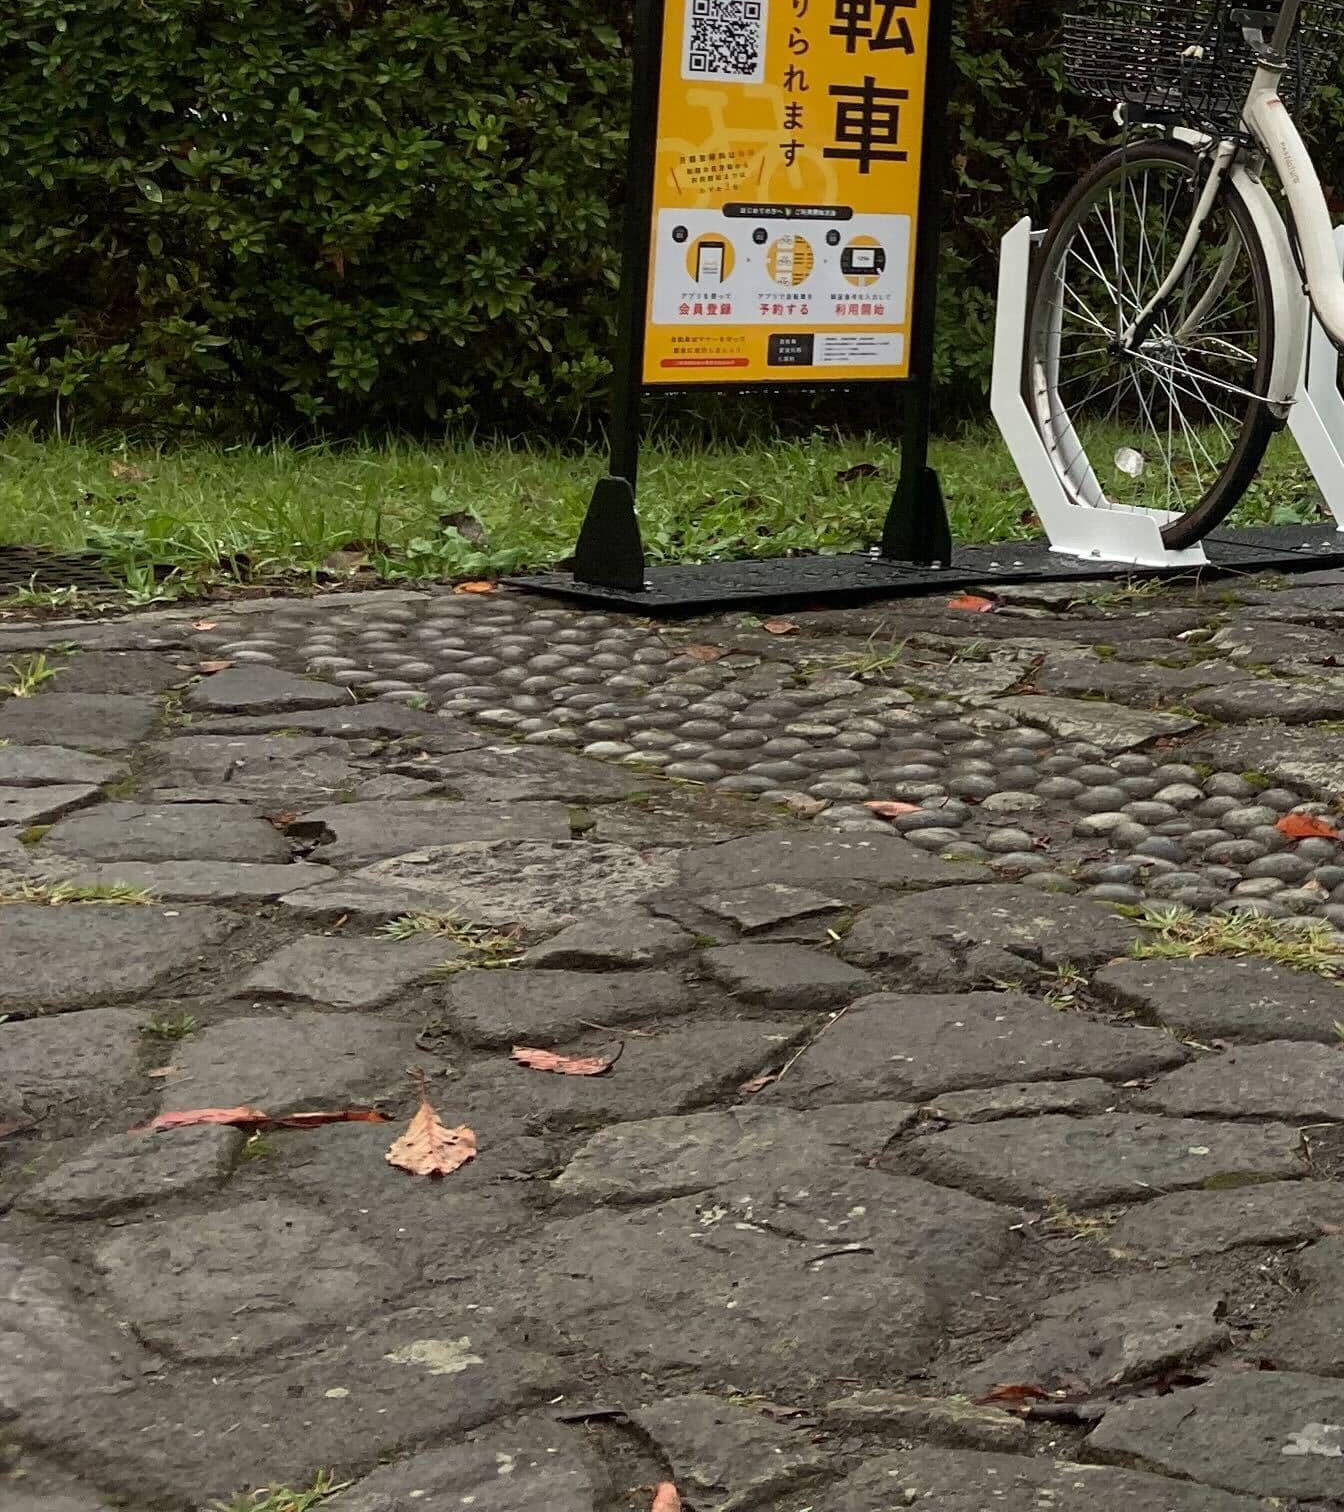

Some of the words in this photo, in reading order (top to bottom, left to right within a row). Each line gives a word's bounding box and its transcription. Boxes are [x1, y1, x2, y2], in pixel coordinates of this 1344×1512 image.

[678, 302, 732, 316] 会員登録
[759, 302, 809, 316] 予約する
[835, 302, 885, 316] 利用開始
